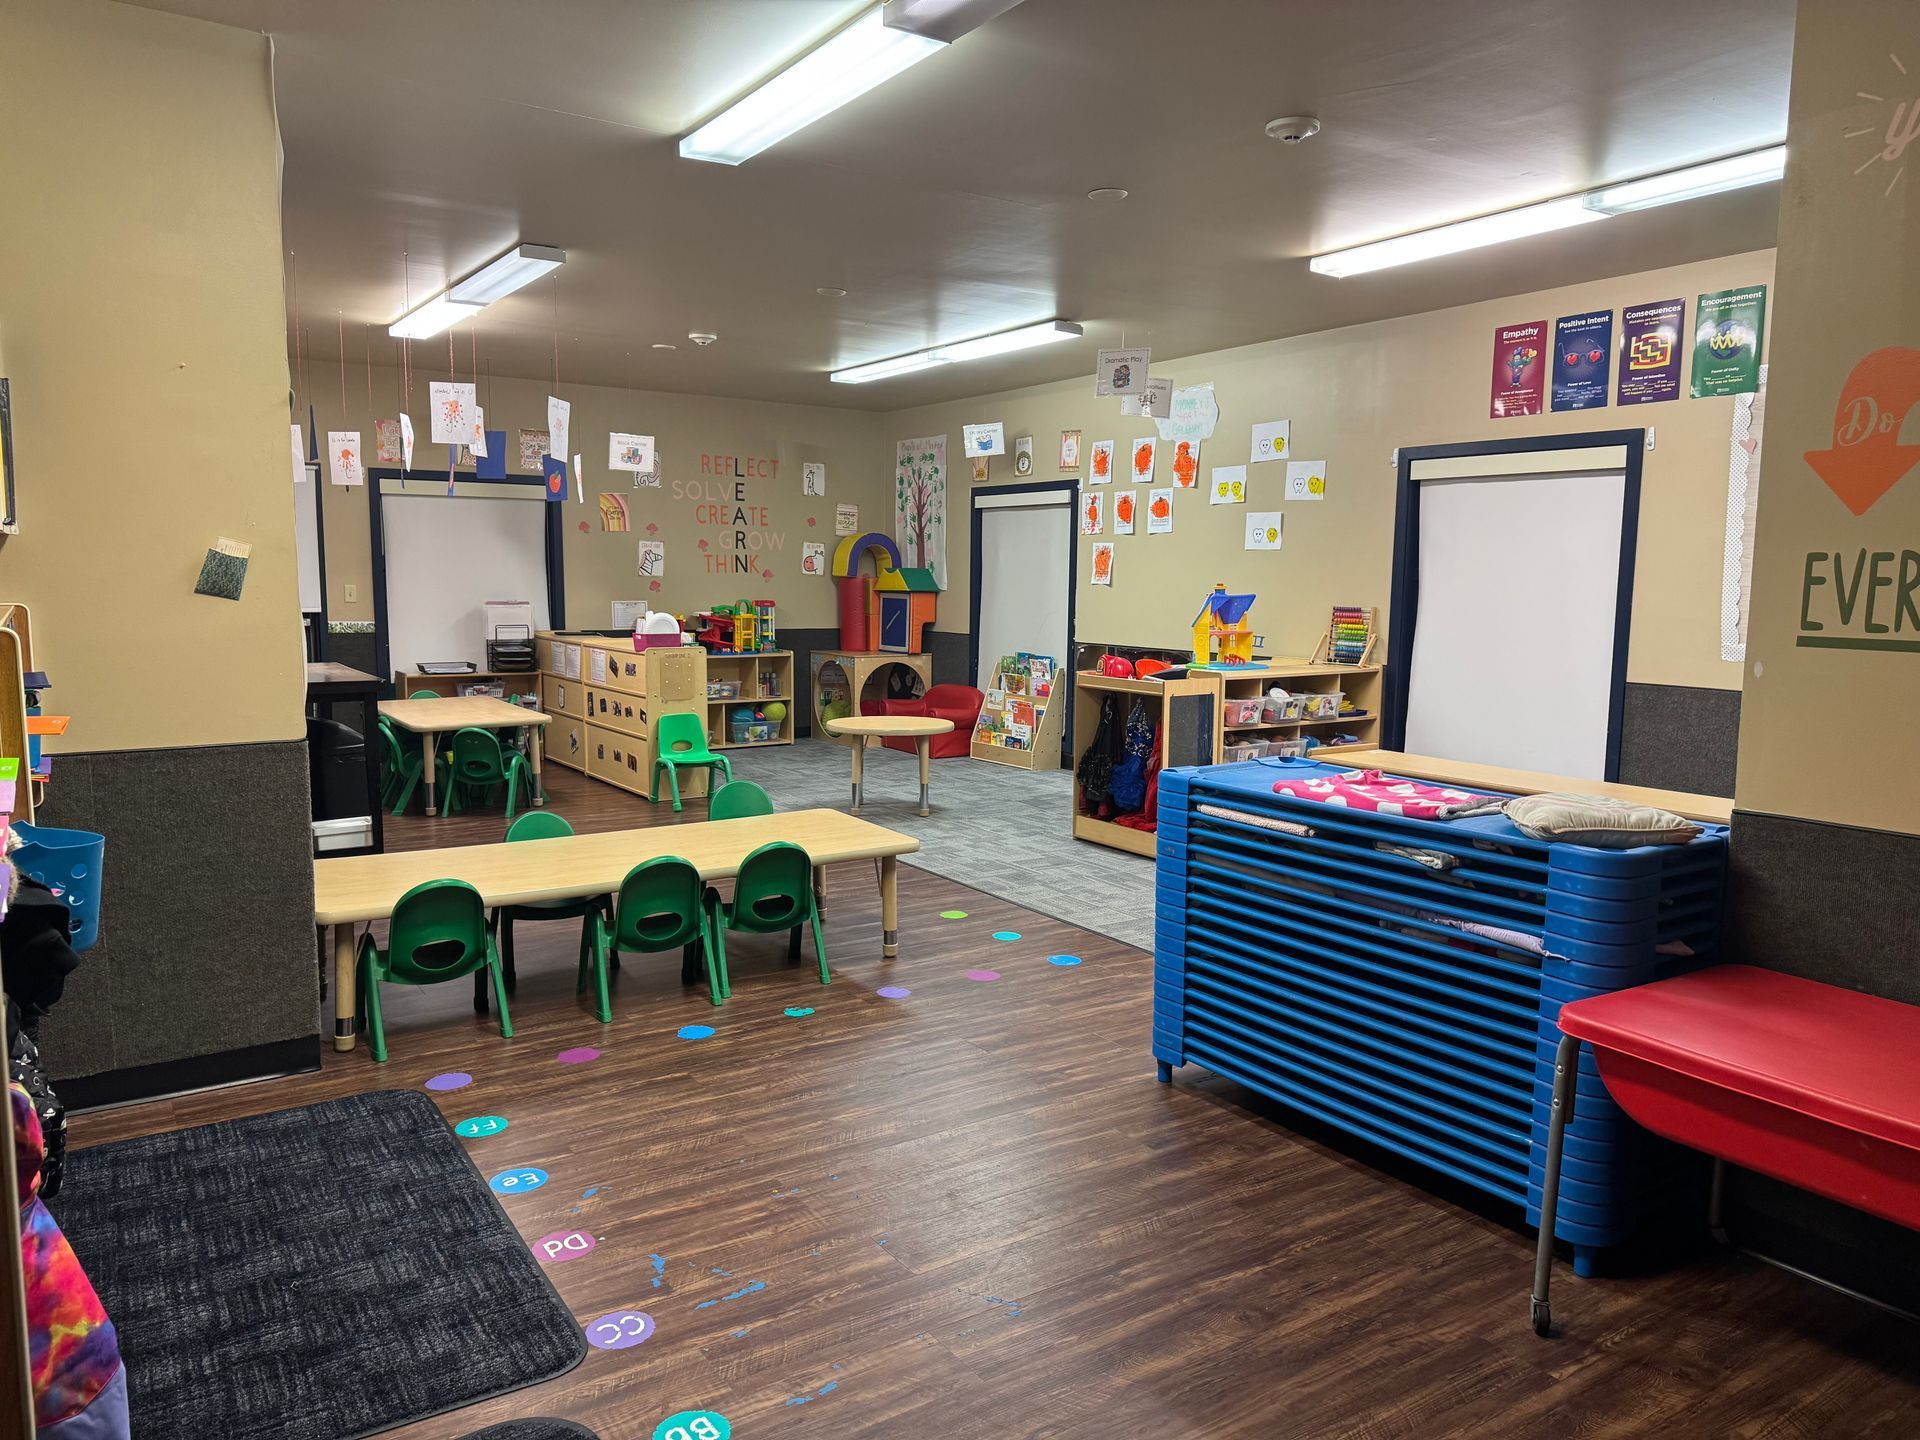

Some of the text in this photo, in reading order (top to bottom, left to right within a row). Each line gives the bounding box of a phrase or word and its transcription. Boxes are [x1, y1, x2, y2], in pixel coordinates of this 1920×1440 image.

[1701, 291, 1762, 306] Encouragement
[1626, 304, 1681, 319] Consequences
[1559, 315, 1609, 329] Positive Intent
[1503, 327, 1539, 339] Empathy
[1105, 355, 1142, 364] Dramatic Play
[1837, 396, 1903, 447] Do
[701, 455, 779, 480] REFLECT
[672, 480, 745, 501] SOLVE
[696, 504, 769, 526] CREATE
[732, 458, 748, 573] LEARN
[718, 530, 786, 551] GROW
[703, 554, 760, 574] THINK
[468, 1119, 498, 1134] Ff
[502, 1173, 541, 1186] Ee
[543, 1233, 589, 1259] Dd
[596, 1315, 645, 1344] Cc
